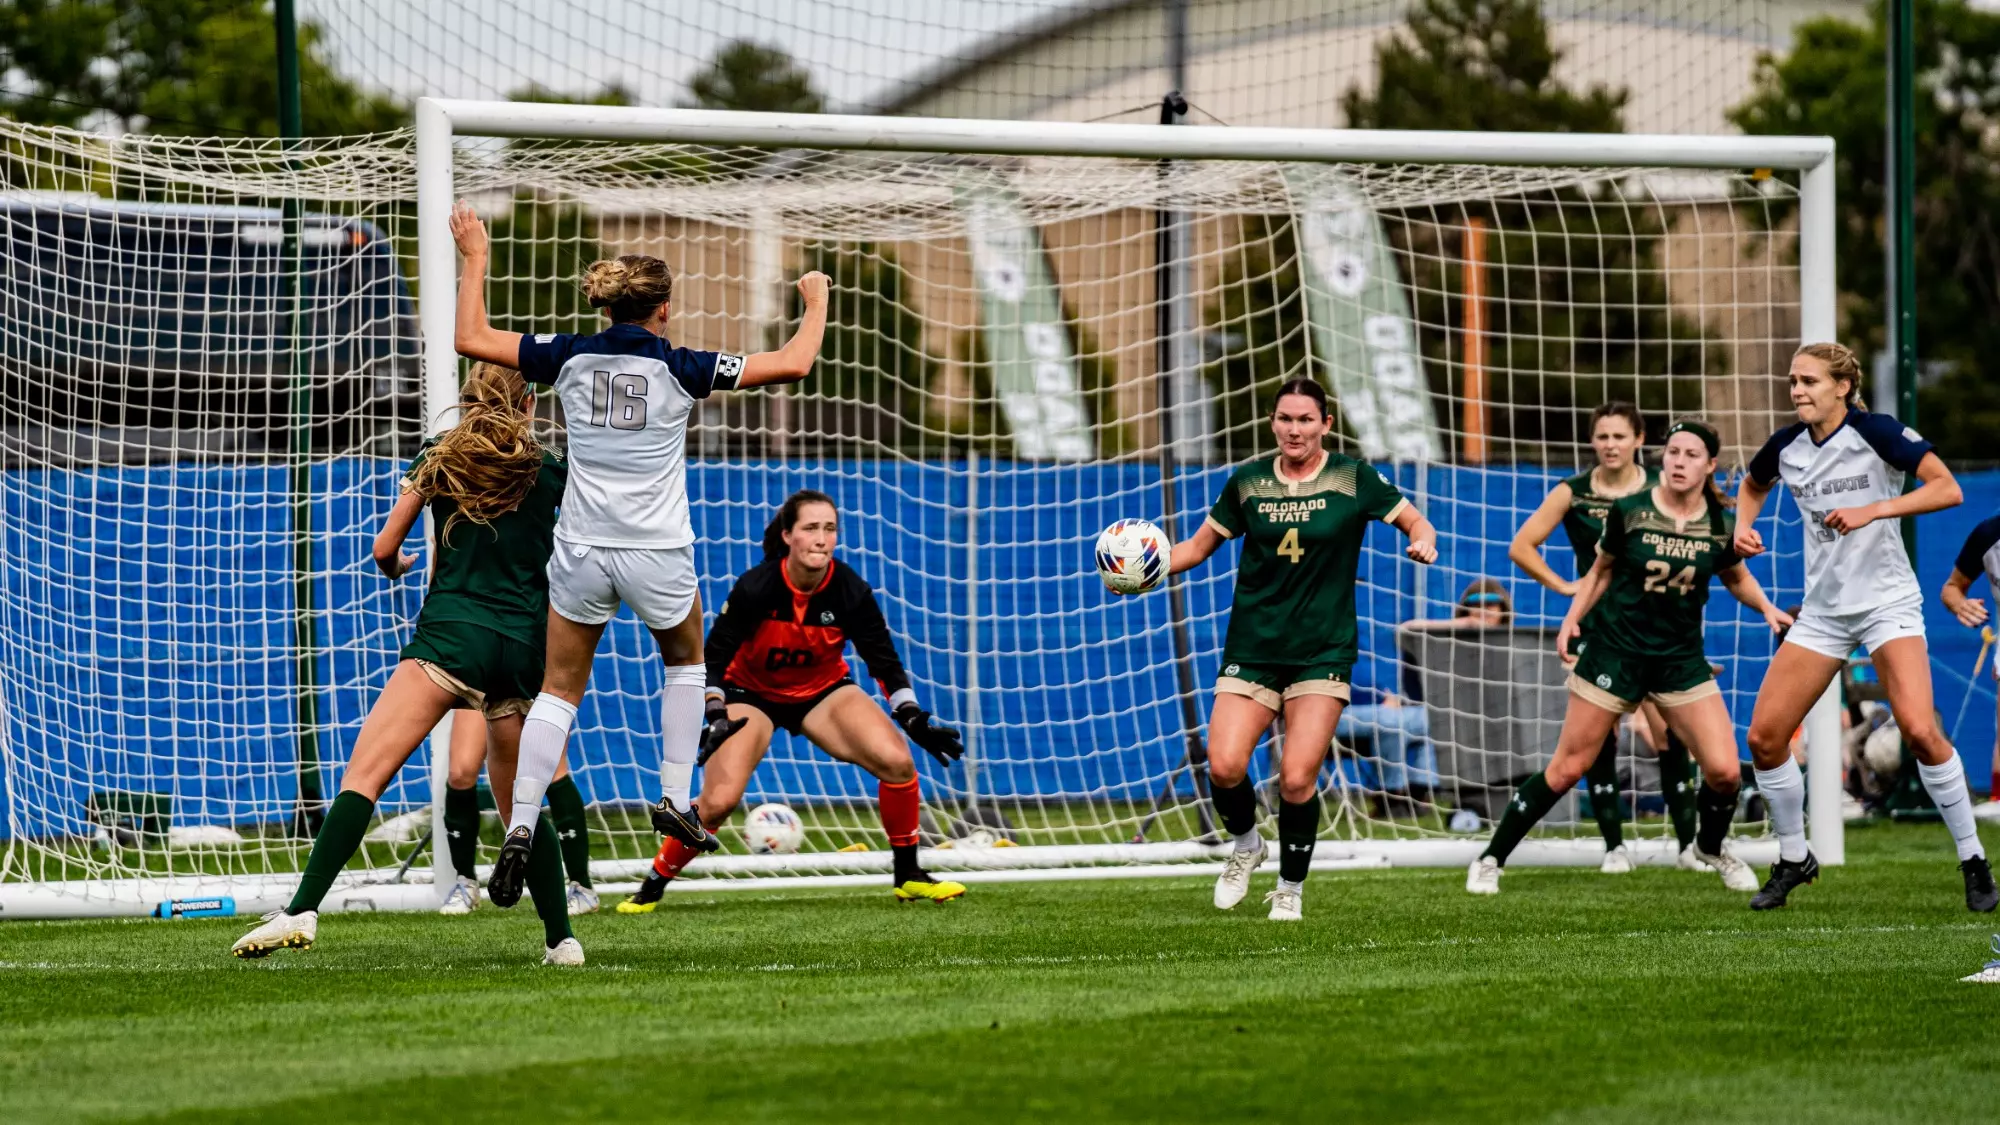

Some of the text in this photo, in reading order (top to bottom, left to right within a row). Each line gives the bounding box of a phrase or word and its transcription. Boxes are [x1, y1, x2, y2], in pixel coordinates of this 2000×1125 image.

[591, 370, 649, 431] 16
[1821, 473, 1870, 495] STATE
[1258, 498, 1326, 513] COLORADO
[1269, 510, 1310, 523] STATE
[1811, 508, 1835, 543] 3
[1277, 527, 1305, 564] 4
[1642, 532, 1711, 552] COLORADO
[1655, 544, 1697, 561] STATE
[1644, 559, 1697, 596] 24
[171, 900, 220, 912] POWERADE
